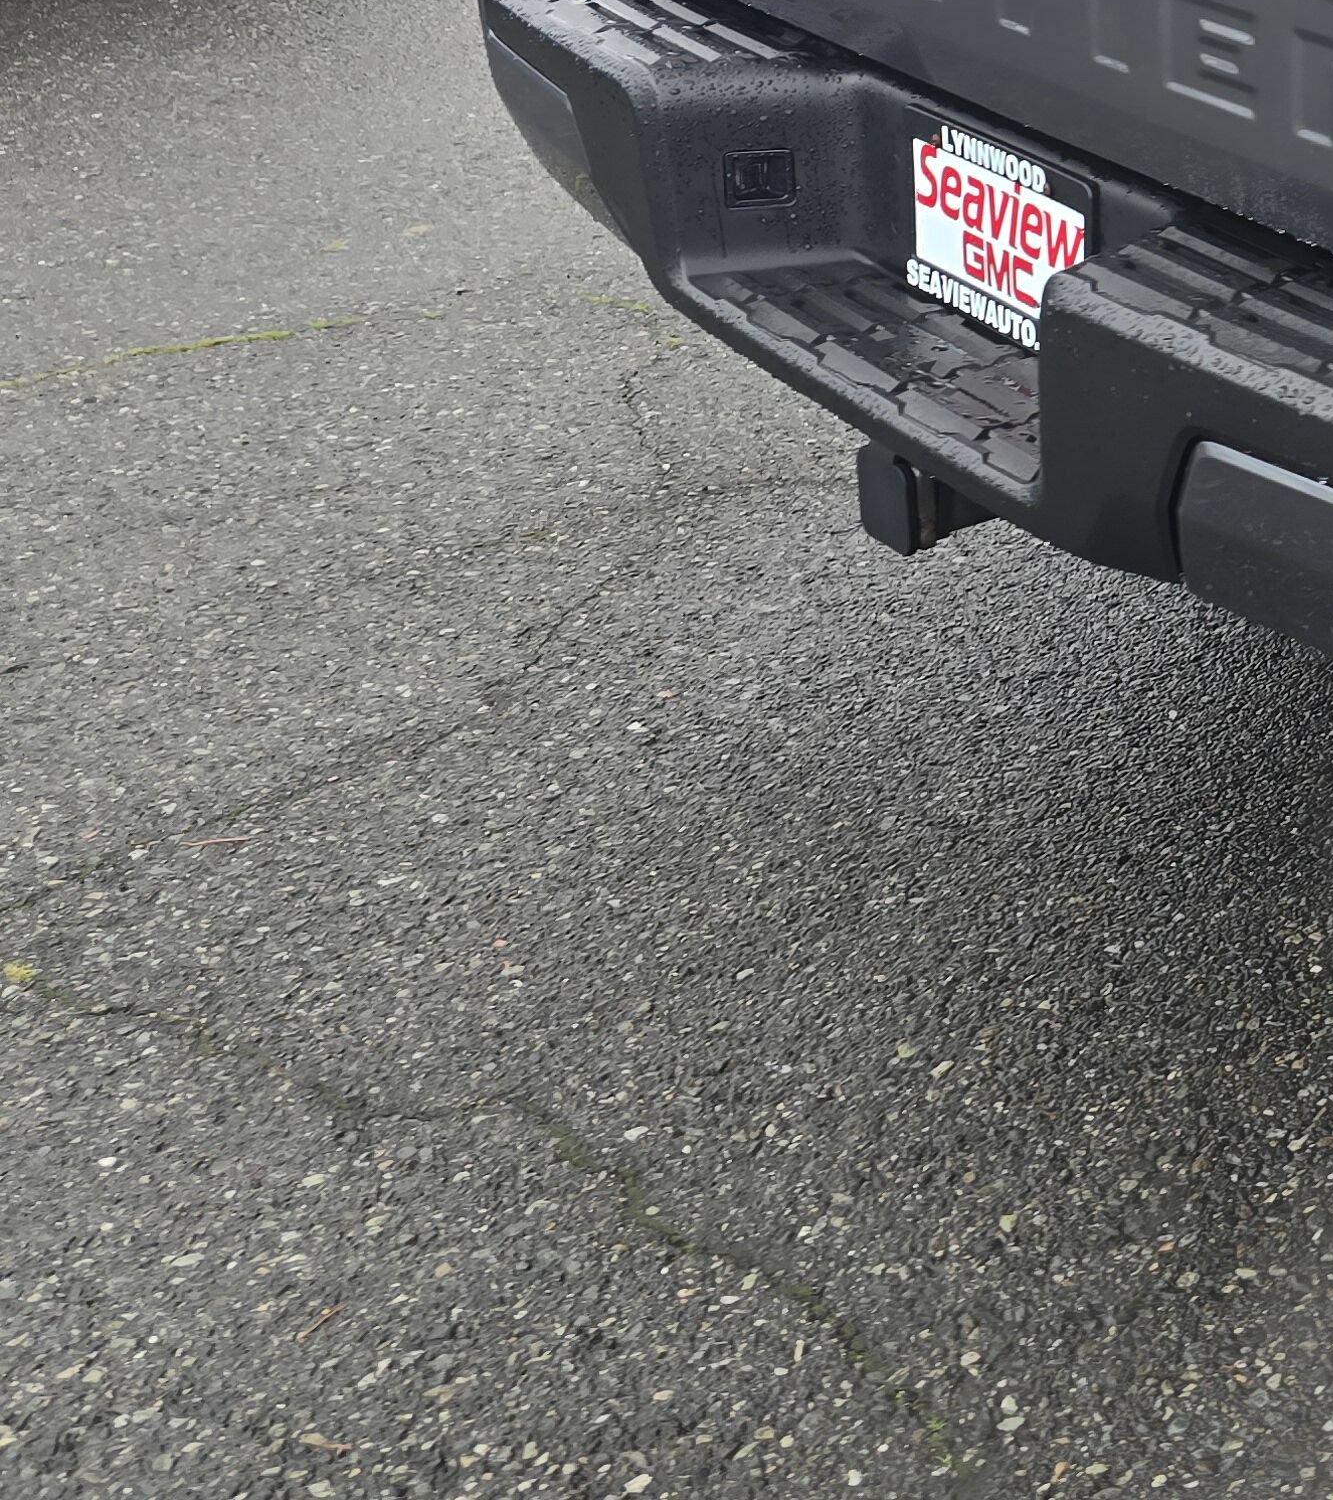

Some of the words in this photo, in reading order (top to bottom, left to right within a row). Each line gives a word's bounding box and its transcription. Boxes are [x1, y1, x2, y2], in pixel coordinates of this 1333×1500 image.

[940, 125, 1048, 193] LYNNWOOD
[915, 143, 1086, 270] Seaview
[962, 230, 1041, 309] GMC
